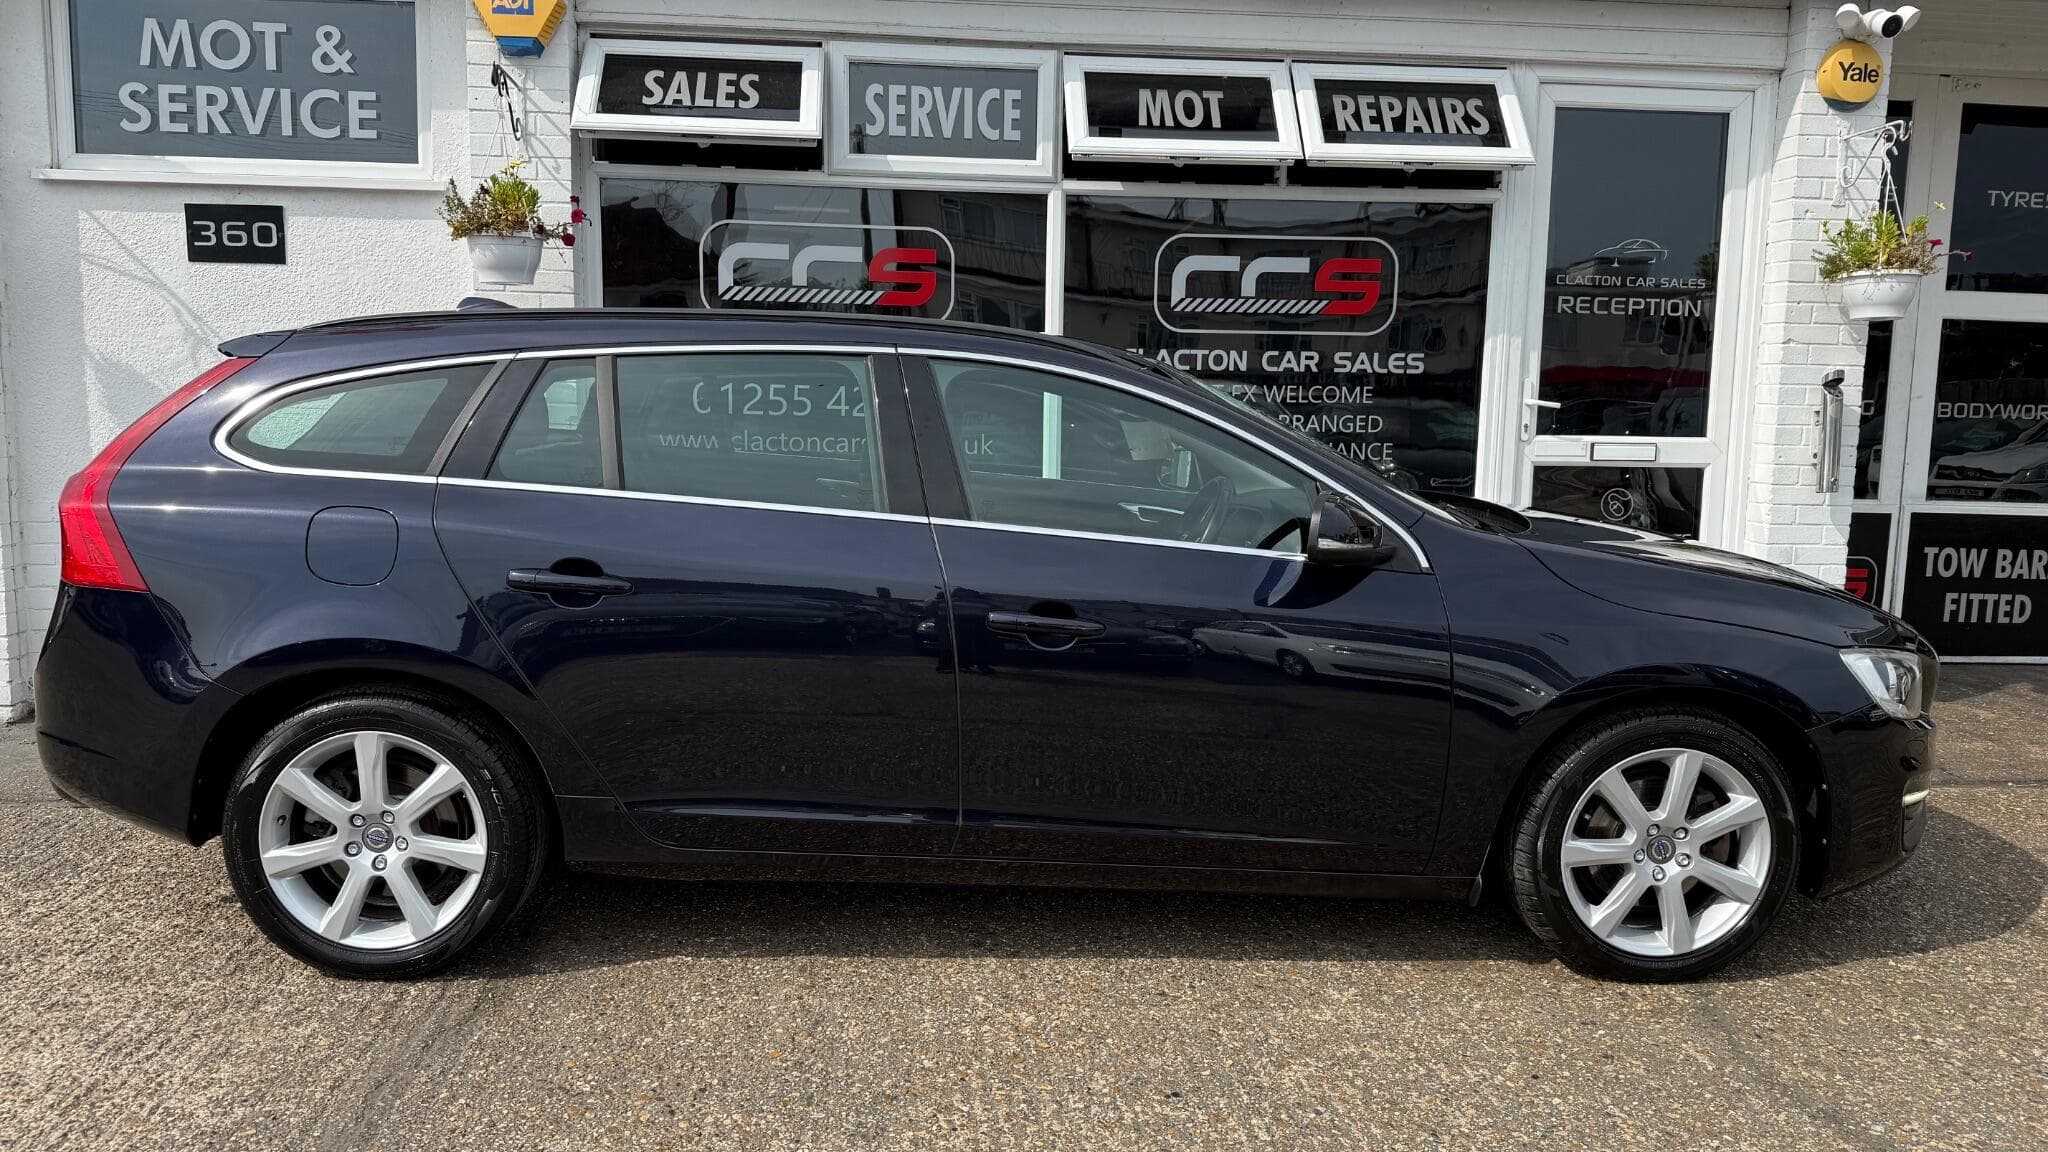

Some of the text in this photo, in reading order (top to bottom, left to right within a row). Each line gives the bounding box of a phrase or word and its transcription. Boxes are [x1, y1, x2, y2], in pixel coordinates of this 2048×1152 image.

[140, 17, 355, 76] MOT &
[1839, 61, 1879, 83] Yale
[642, 69, 760, 109] SALES
[118, 82, 378, 139] SERVICE
[864, 83, 1021, 141] SERVICE
[1138, 88, 1223, 129] MOT
[1332, 94, 1490, 136] REPAIRS
[1988, 190, 2048, 208] TYRE
[193, 220, 278, 248] 360
[1557, 274, 1706, 289] CLACTON CAR SALES
[1557, 296, 1701, 317] RECEPTION
[1126, 348, 1424, 374] ACTON CAR SALES
[1264, 385, 1374, 405] WELCOME
[1923, 546, 2048, 580] TOW BAR
[1943, 593, 2032, 624] FITTED
